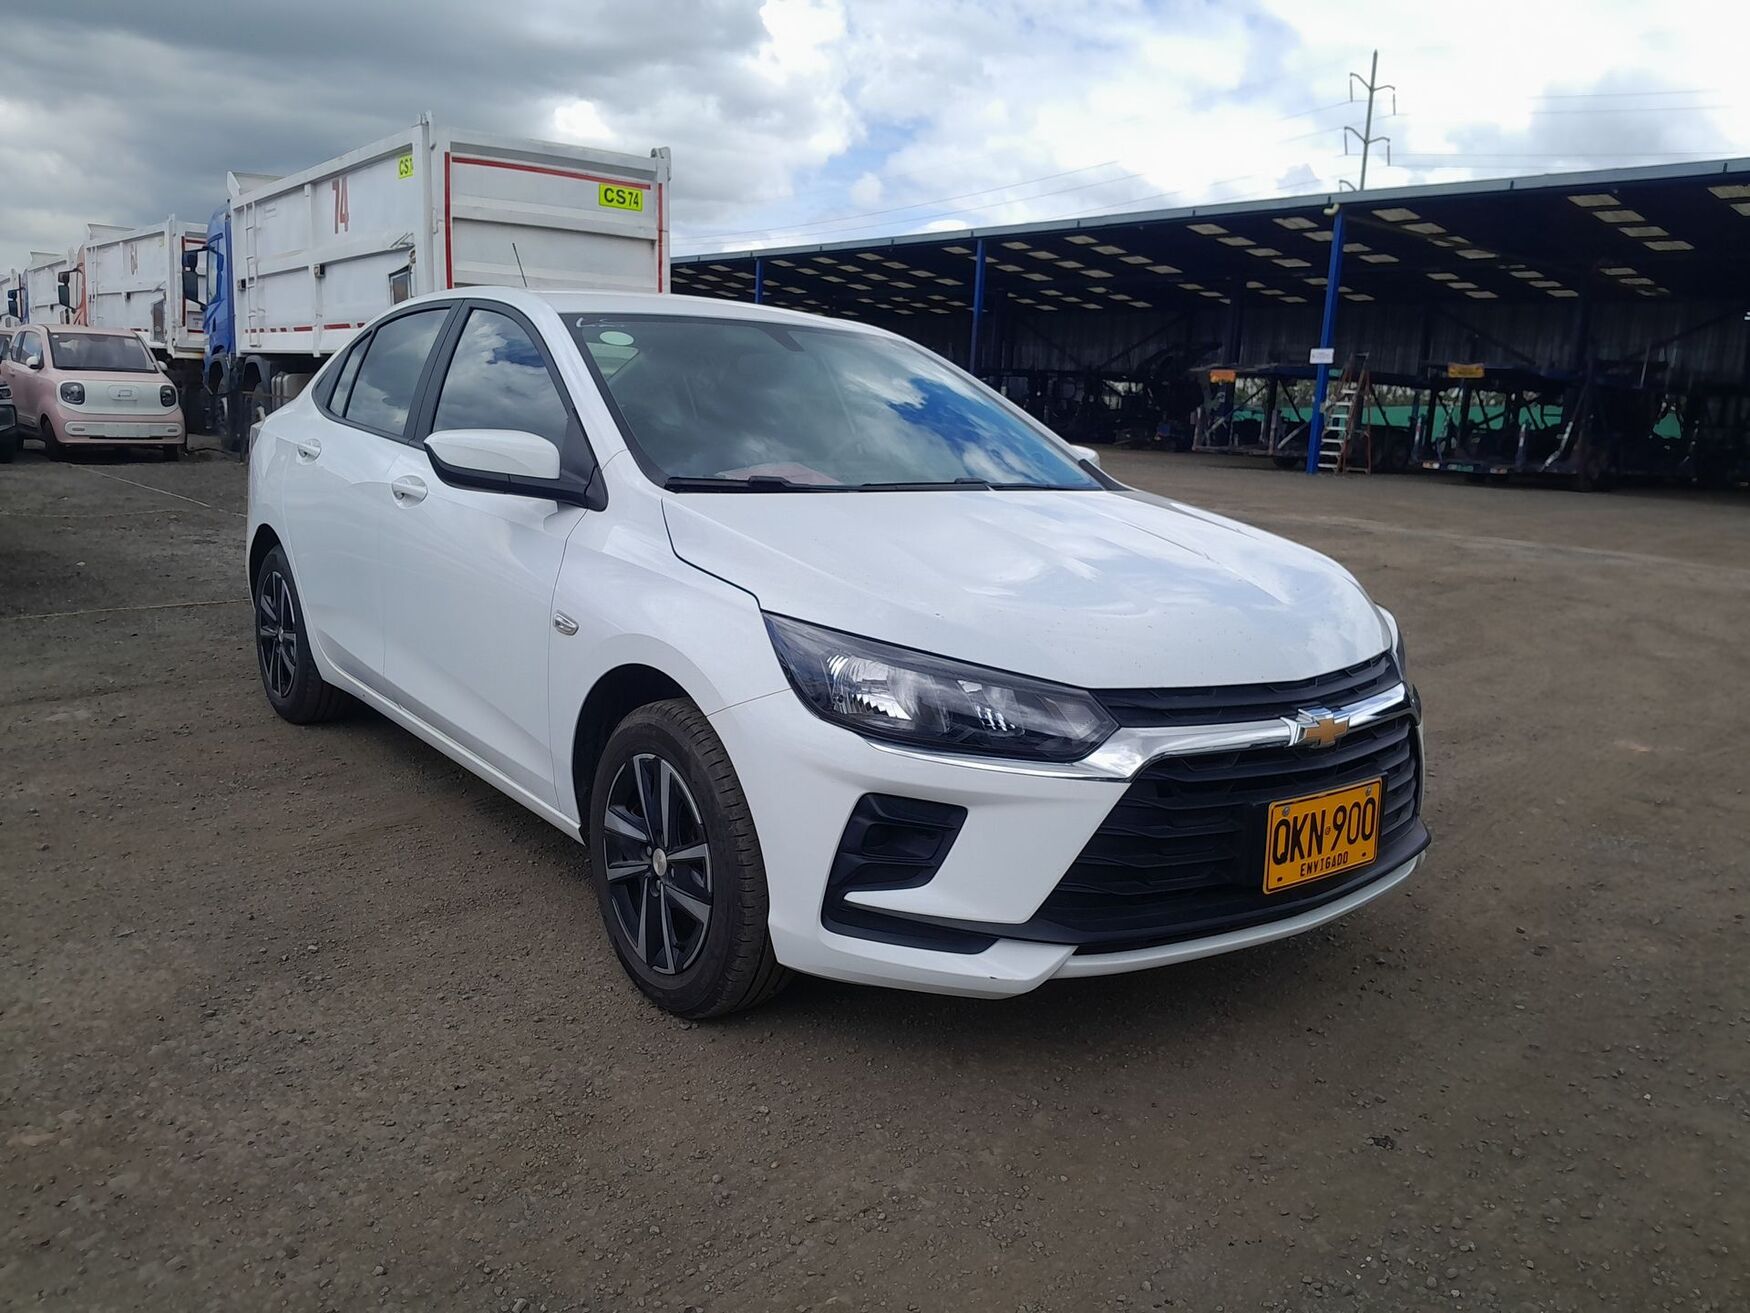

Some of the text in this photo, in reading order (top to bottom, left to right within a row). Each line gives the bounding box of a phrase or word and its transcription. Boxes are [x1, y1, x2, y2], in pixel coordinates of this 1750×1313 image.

[332, 176, 349, 234] 74
[604, 187, 639, 208] CS74
[1300, 851, 1348, 876] ENVIGADO
